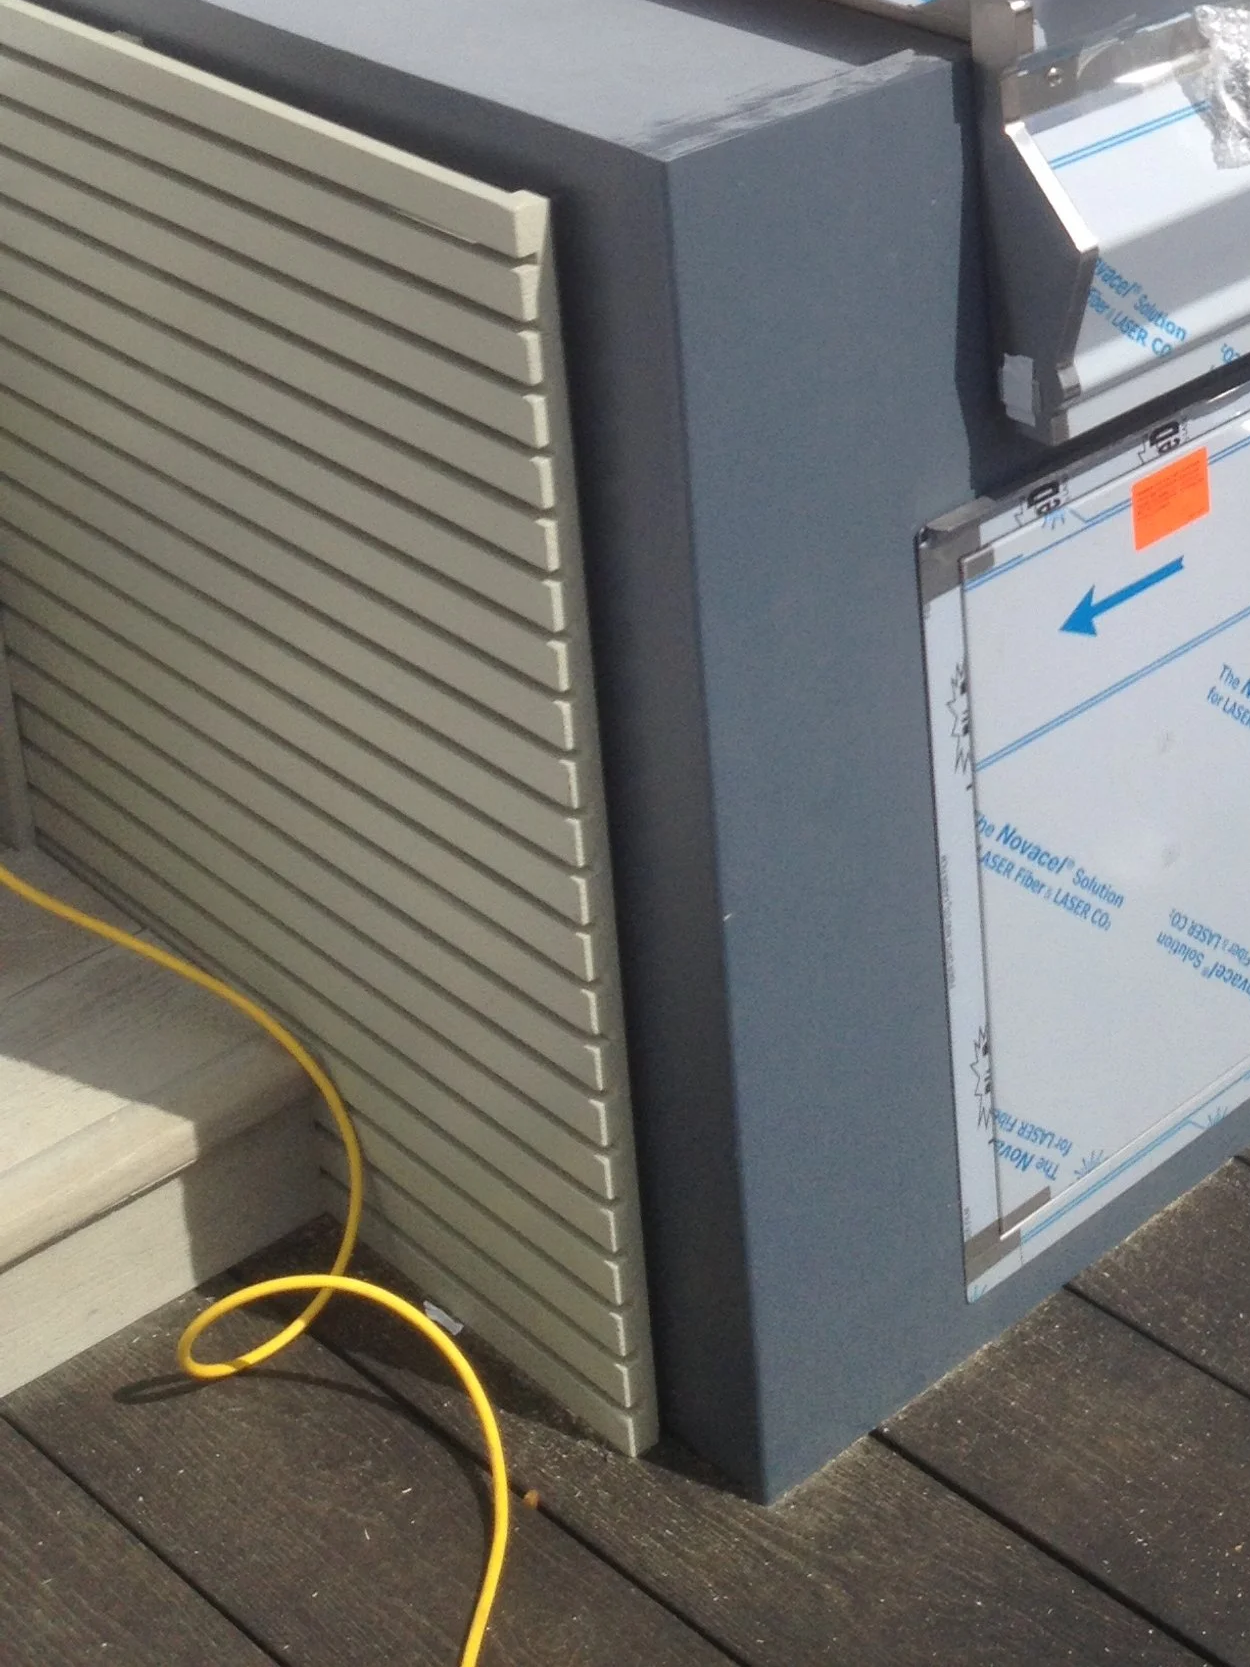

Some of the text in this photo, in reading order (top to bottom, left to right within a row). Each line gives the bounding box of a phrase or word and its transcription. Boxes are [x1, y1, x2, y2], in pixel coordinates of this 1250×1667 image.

[1112, 310, 1148, 347] LASER
[1219, 664, 1241, 690] The
[1207, 685, 1224, 707] for
[980, 850, 1015, 880] ASER
[1014, 866, 1046, 895] Fiber
[1053, 887, 1091, 920] LASER
[1072, 866, 1125, 908] Solution
[1187, 919, 1222, 950] LASER
[1156, 931, 1205, 970] Solution
[1017, 1120, 1055, 1149] LASER
[1055, 1135, 1073, 1158] for
[1035, 1157, 1060, 1182] The
